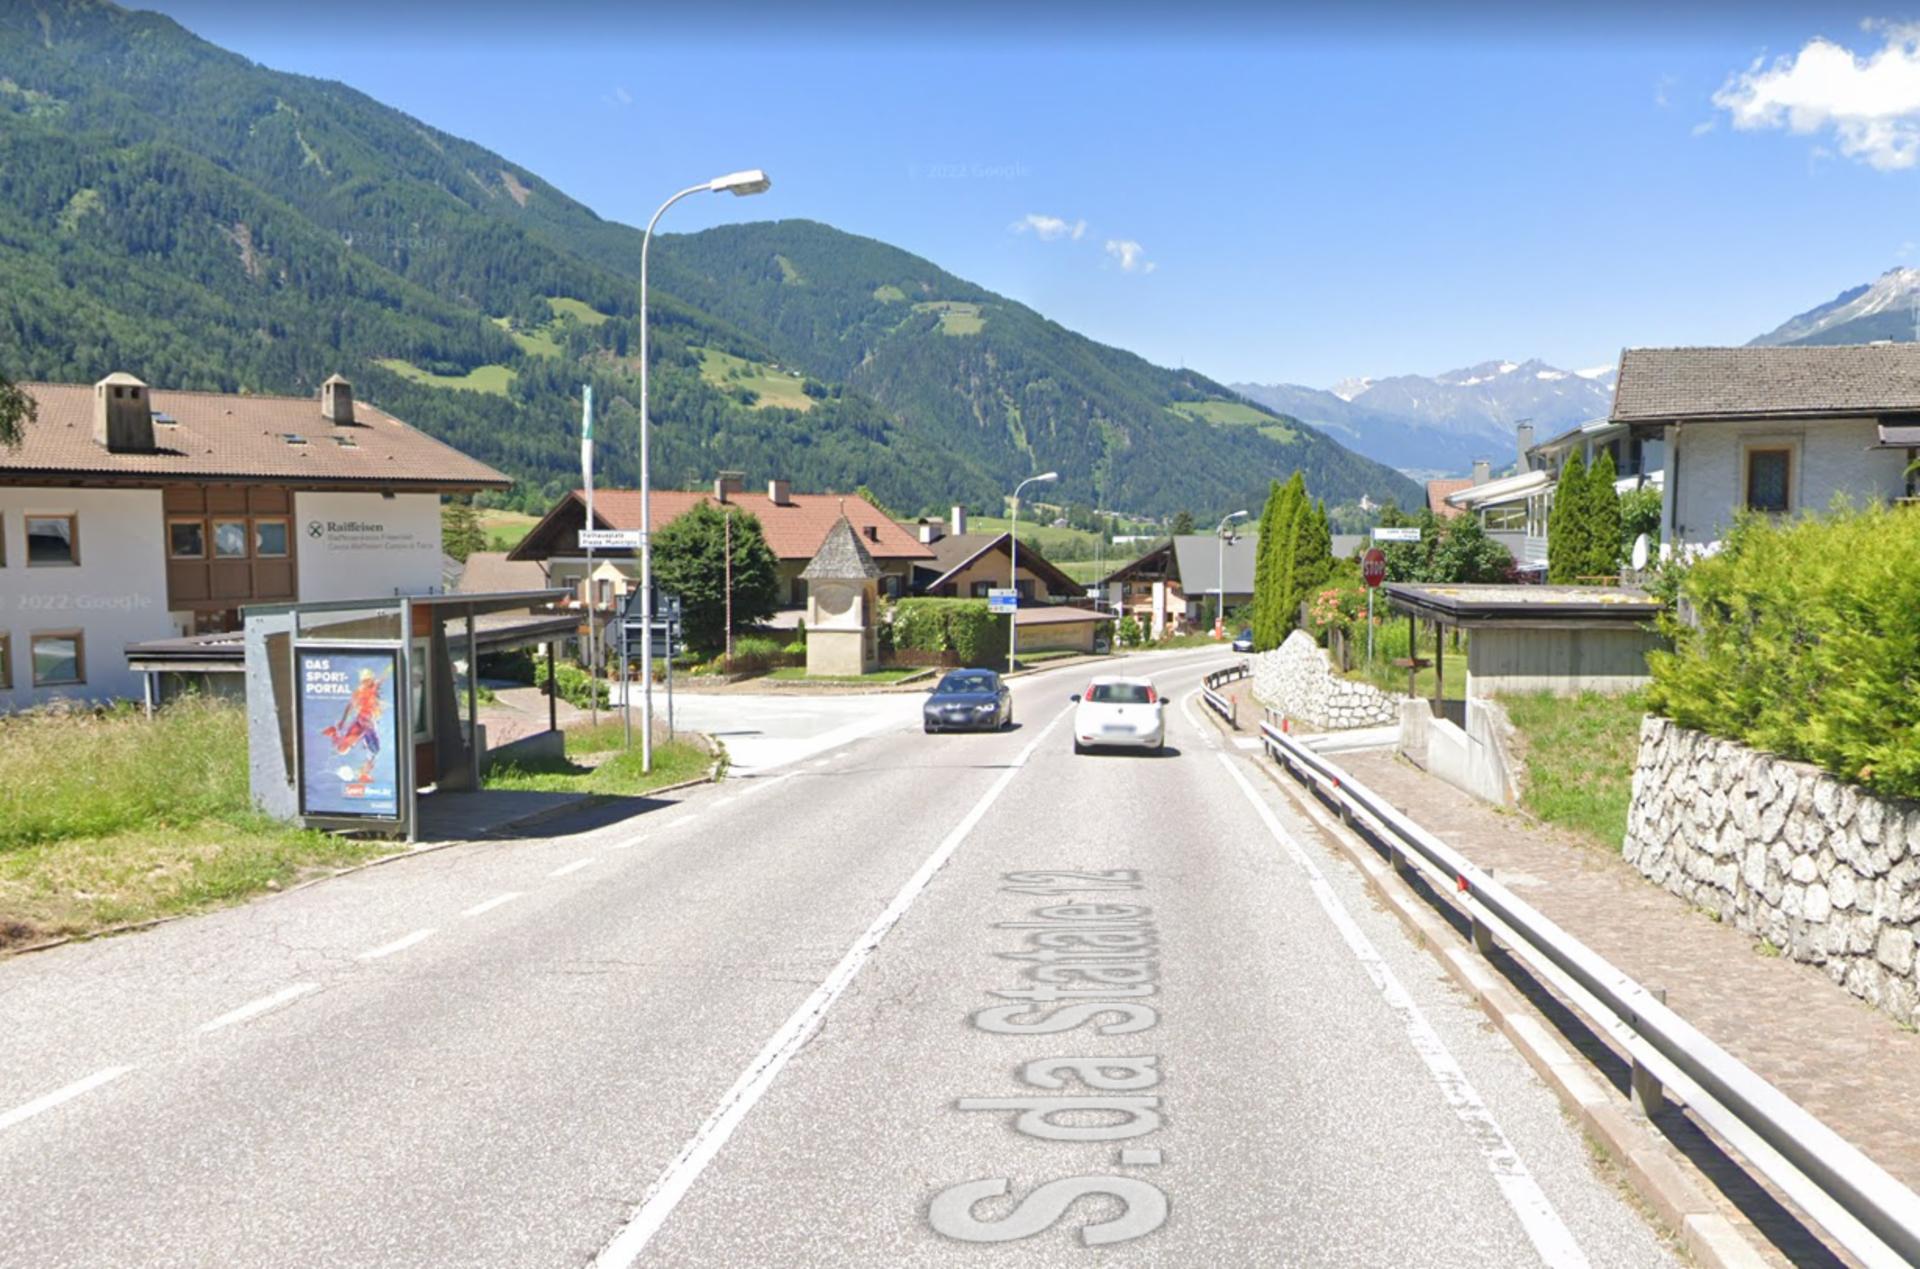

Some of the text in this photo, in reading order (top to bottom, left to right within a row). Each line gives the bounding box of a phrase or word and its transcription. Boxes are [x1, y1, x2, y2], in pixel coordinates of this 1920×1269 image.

[327, 521, 383, 533] Raiffeisen
[1364, 560, 1385, 576] STOP
[305, 659, 330, 670] DAS
[306, 671, 349, 682] SPORT-
[306, 683, 351, 694] PORTAL
